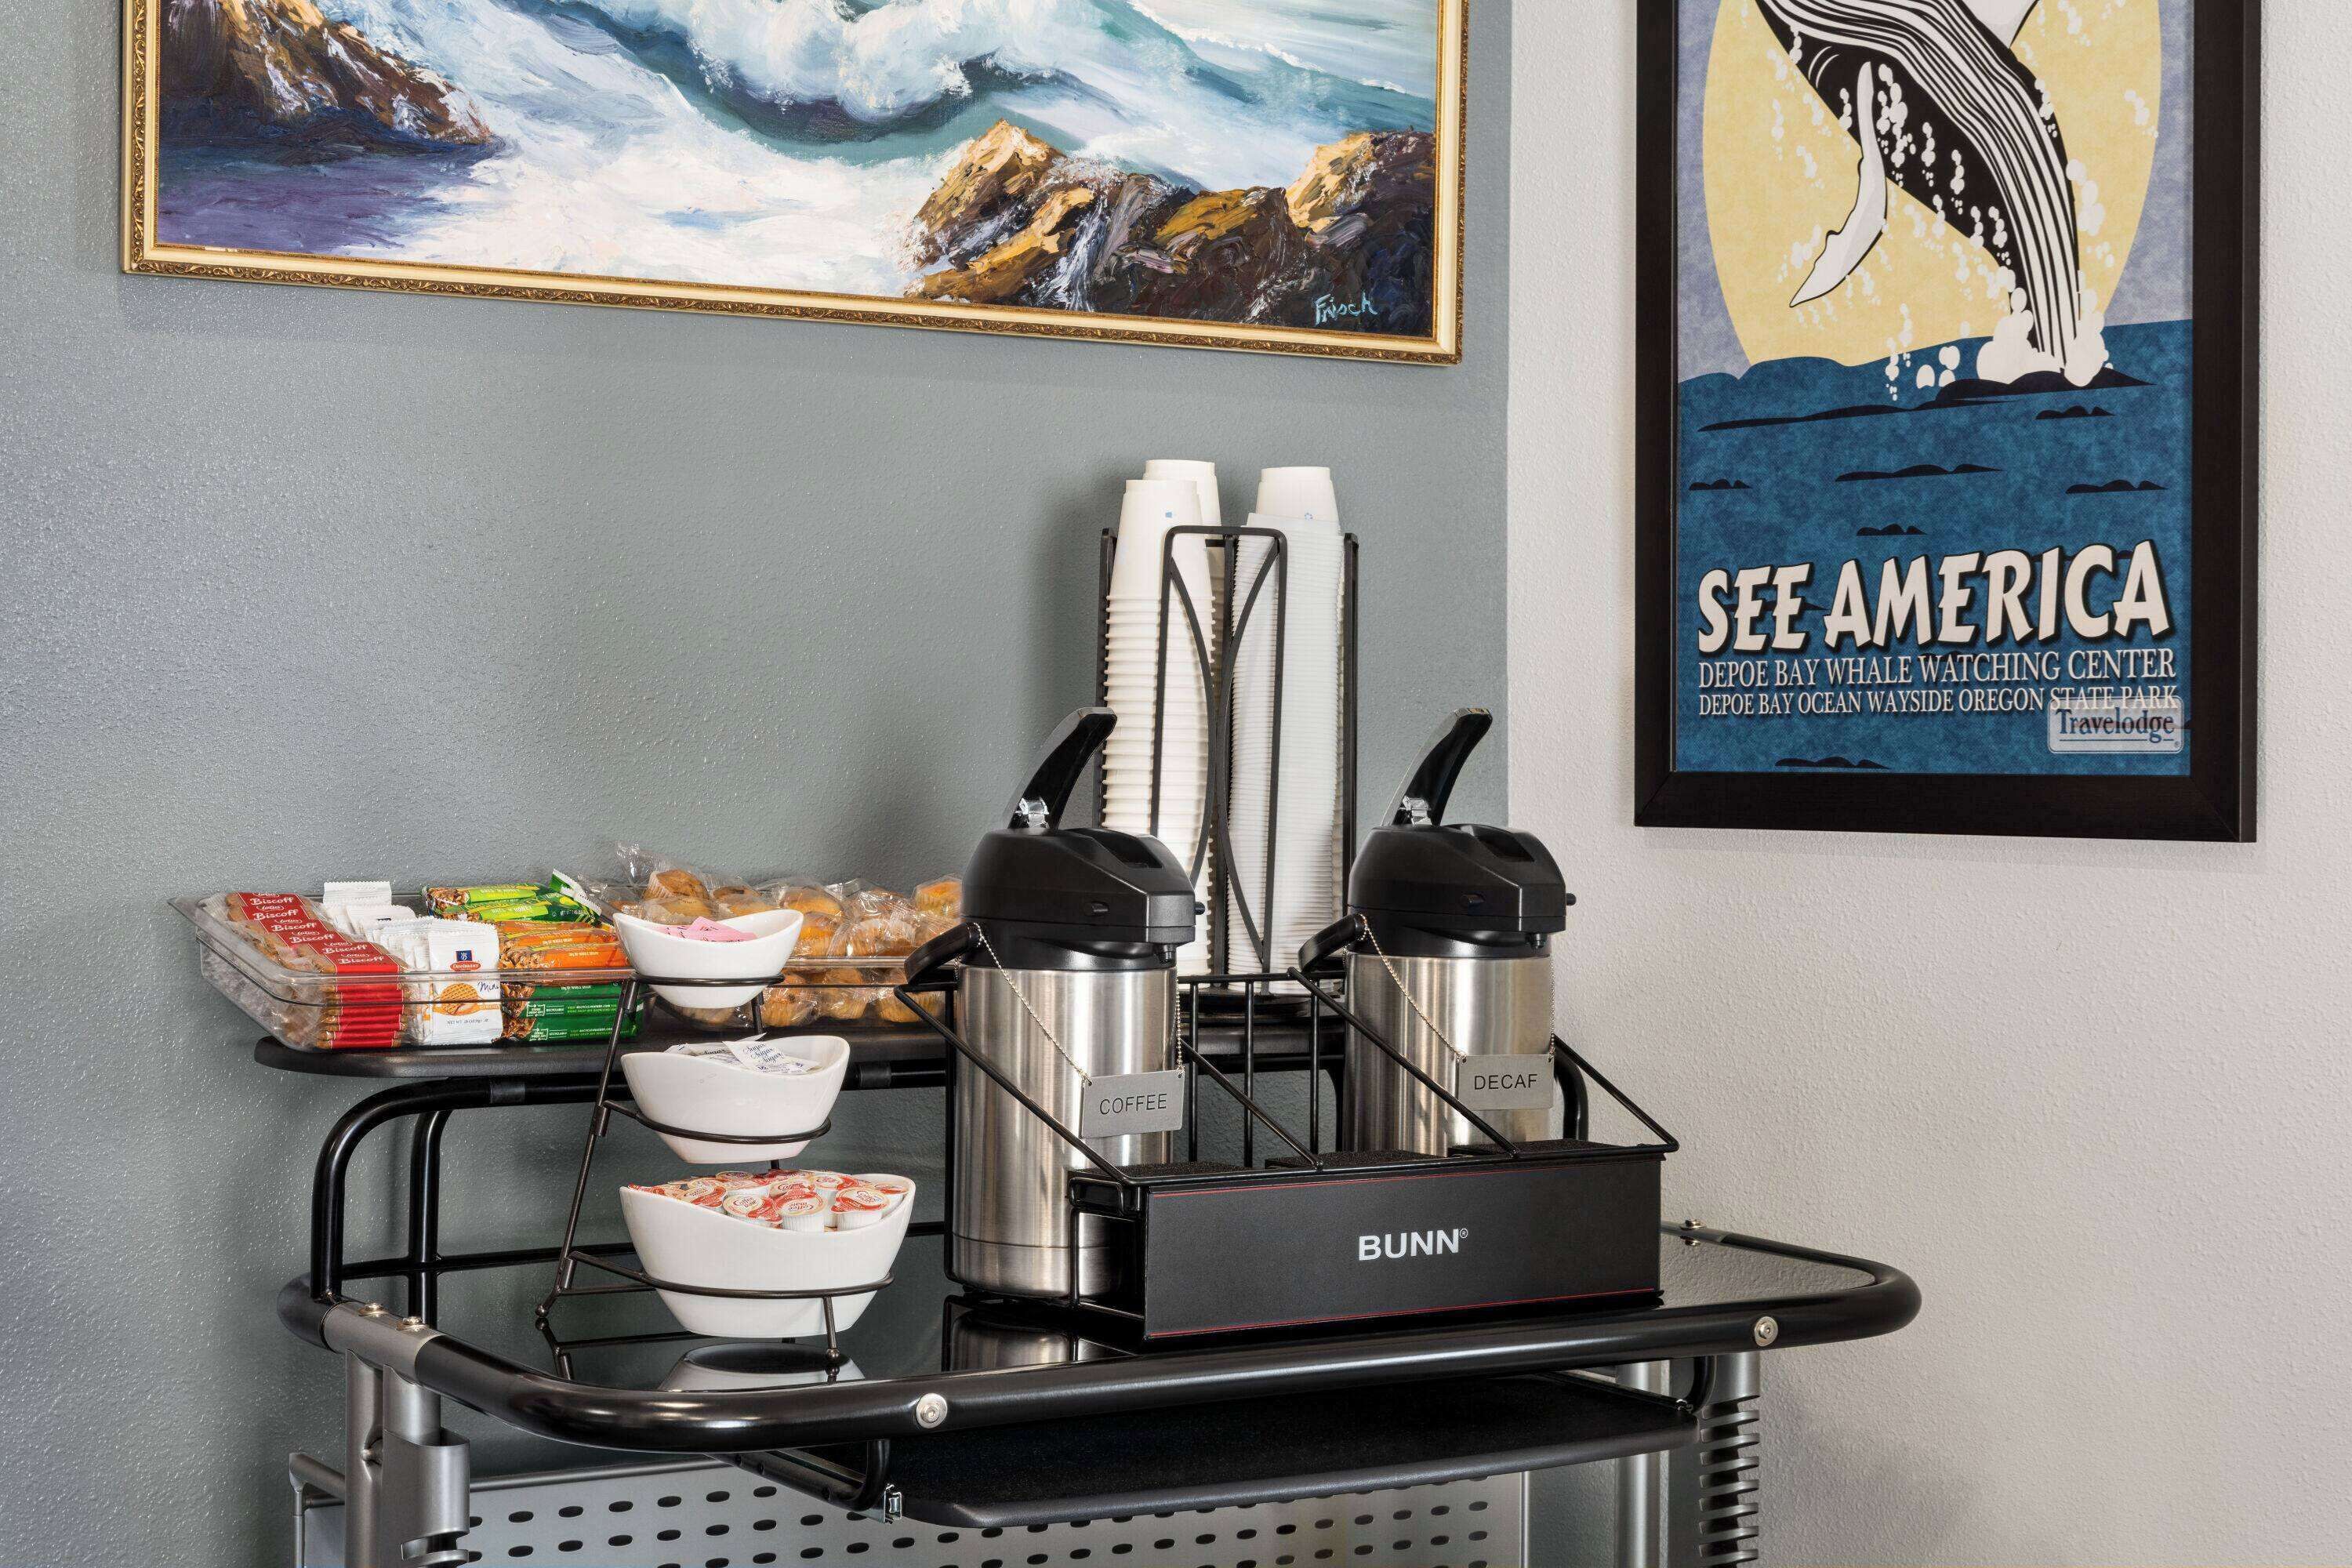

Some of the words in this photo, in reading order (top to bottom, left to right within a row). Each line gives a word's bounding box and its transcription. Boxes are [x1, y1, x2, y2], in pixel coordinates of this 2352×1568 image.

[1697, 563, 1812, 652] SEE
[1824, 539, 2171, 648] AMERICA
[1698, 659, 1769, 688] DEPOE
[1774, 659, 1820, 686] BAY
[1825, 655, 1912, 685] WHALE
[1918, 651, 2061, 683] WATCHING
[2067, 648, 2176, 680] CENTER
[1699, 693, 1754, 716] DEPOE
[1759, 692, 1794, 714] BAY
[1798, 691, 1861, 714] OCEAN
[1866, 688, 1954, 713] WAYSIDE
[1958, 688, 2045, 712] OREGON
[2050, 686, 2114, 710] STATE
[2120, 685, 2179, 710] PARK
[2056, 706, 2175, 744] Travelodge
[250, 897, 294, 906] Biscoff
[253, 909, 299, 920] Biscoff
[271, 923, 317, 932] Biscoff
[289, 934, 334, 943] Biscoff
[322, 945, 367, 954] Biscoff
[1474, 1073, 1538, 1091] DECAF
[1099, 1093, 1168, 1116] COFFEE
